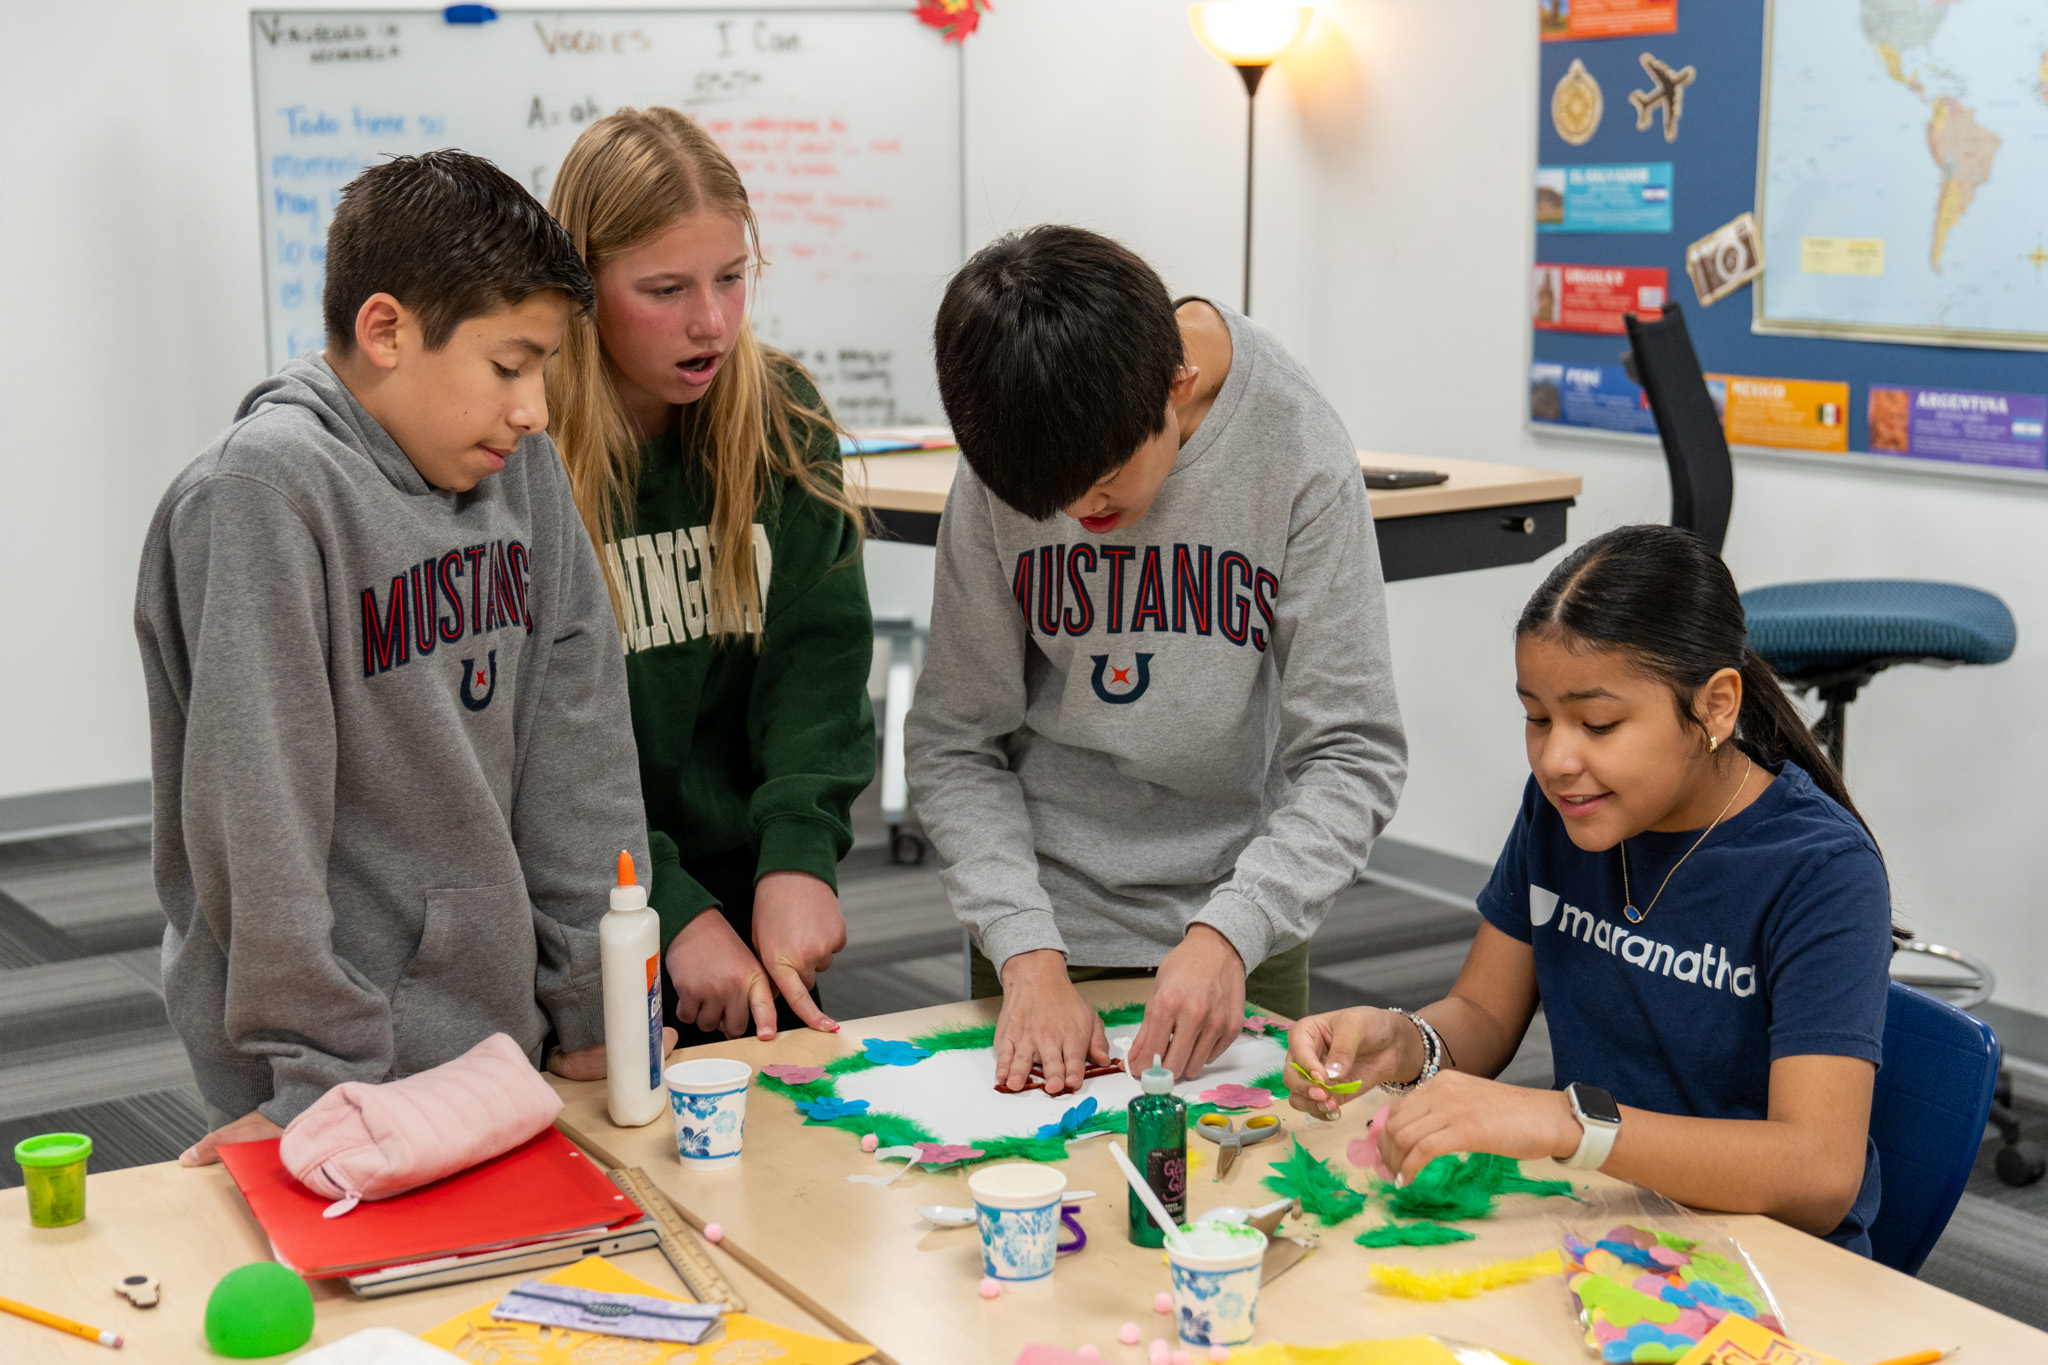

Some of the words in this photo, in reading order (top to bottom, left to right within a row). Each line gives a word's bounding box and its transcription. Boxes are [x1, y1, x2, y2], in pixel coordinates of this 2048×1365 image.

[278, 104, 340, 134] Todo
[1916, 391, 2010, 416] ARGENTINA
[360, 539, 533, 678] MUSTANG
[1558, 902, 1757, 998] maranatha
